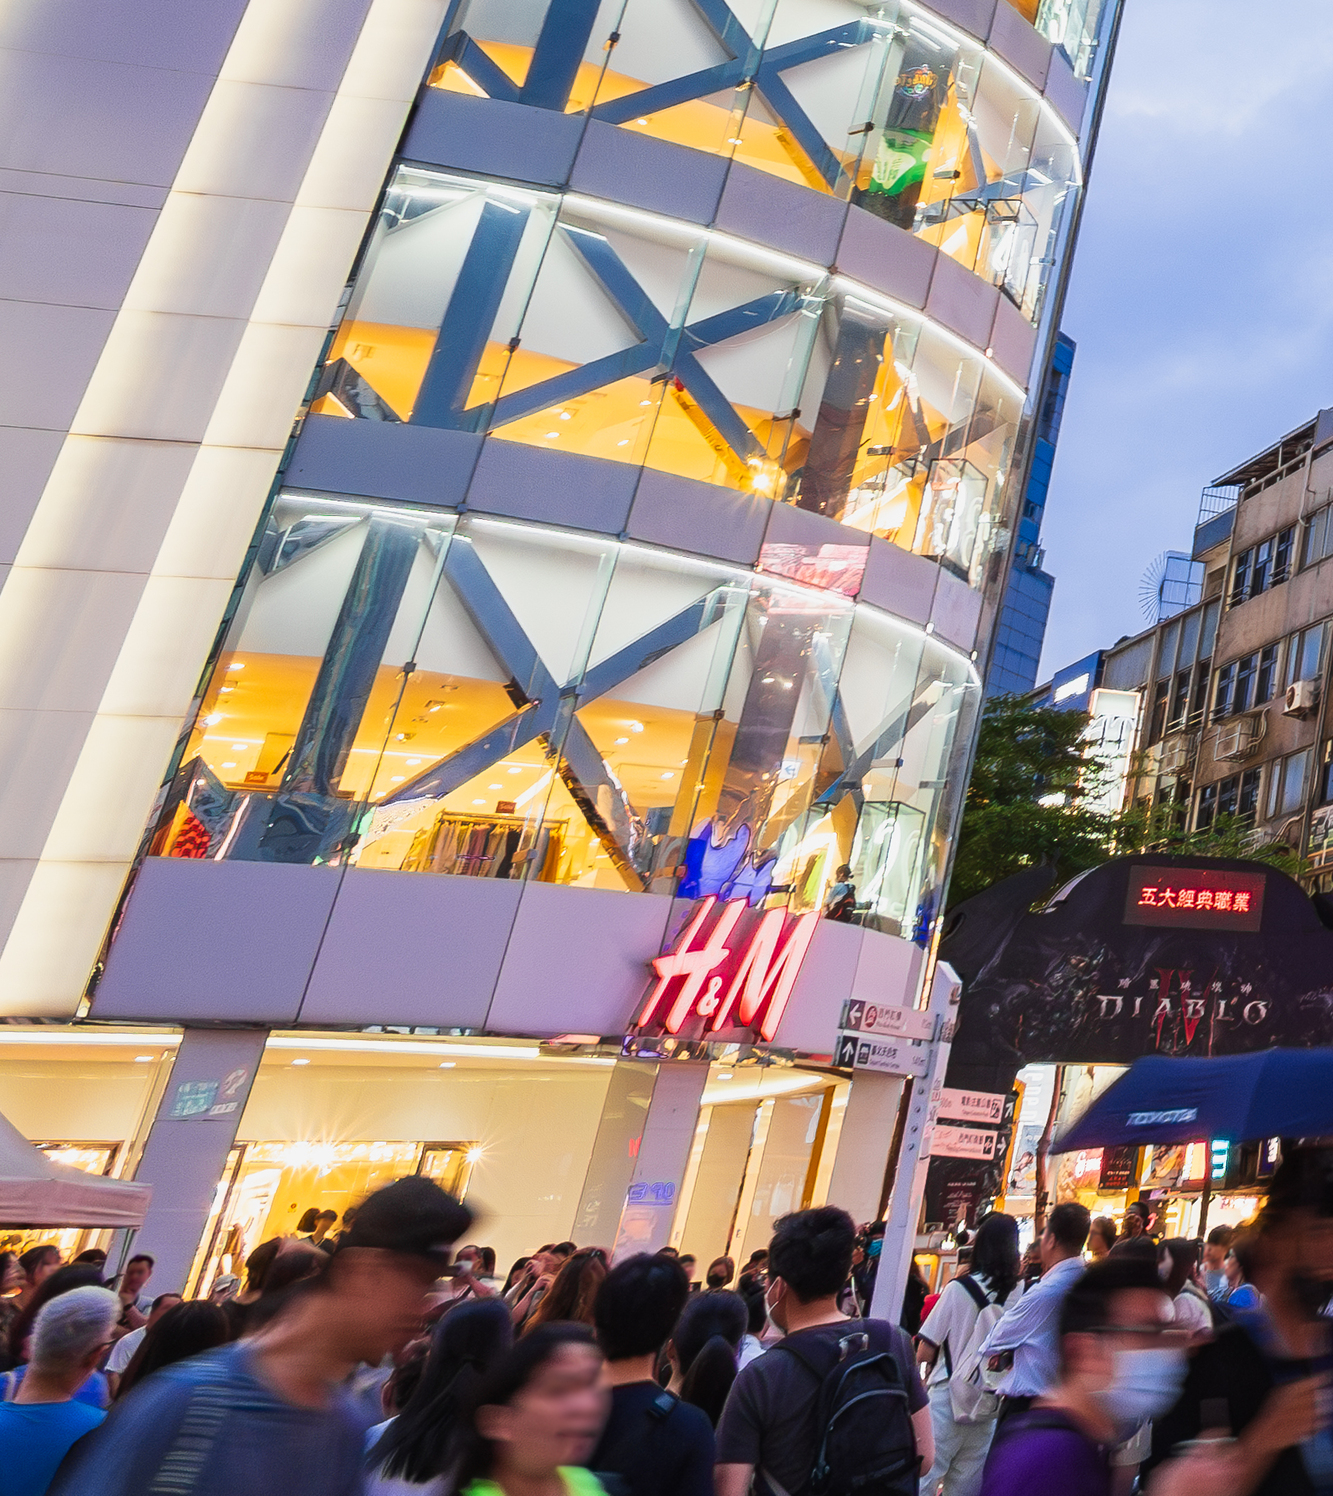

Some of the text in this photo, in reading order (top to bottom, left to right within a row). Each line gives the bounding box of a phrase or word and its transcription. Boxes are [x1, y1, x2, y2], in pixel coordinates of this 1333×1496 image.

[1137, 886, 1251, 914] 五大經典職業
[636, 896, 822, 1043] H&M
[1098, 994, 1273, 1026] DIABLO
[1125, 1107, 1199, 1127] TOYOTA
